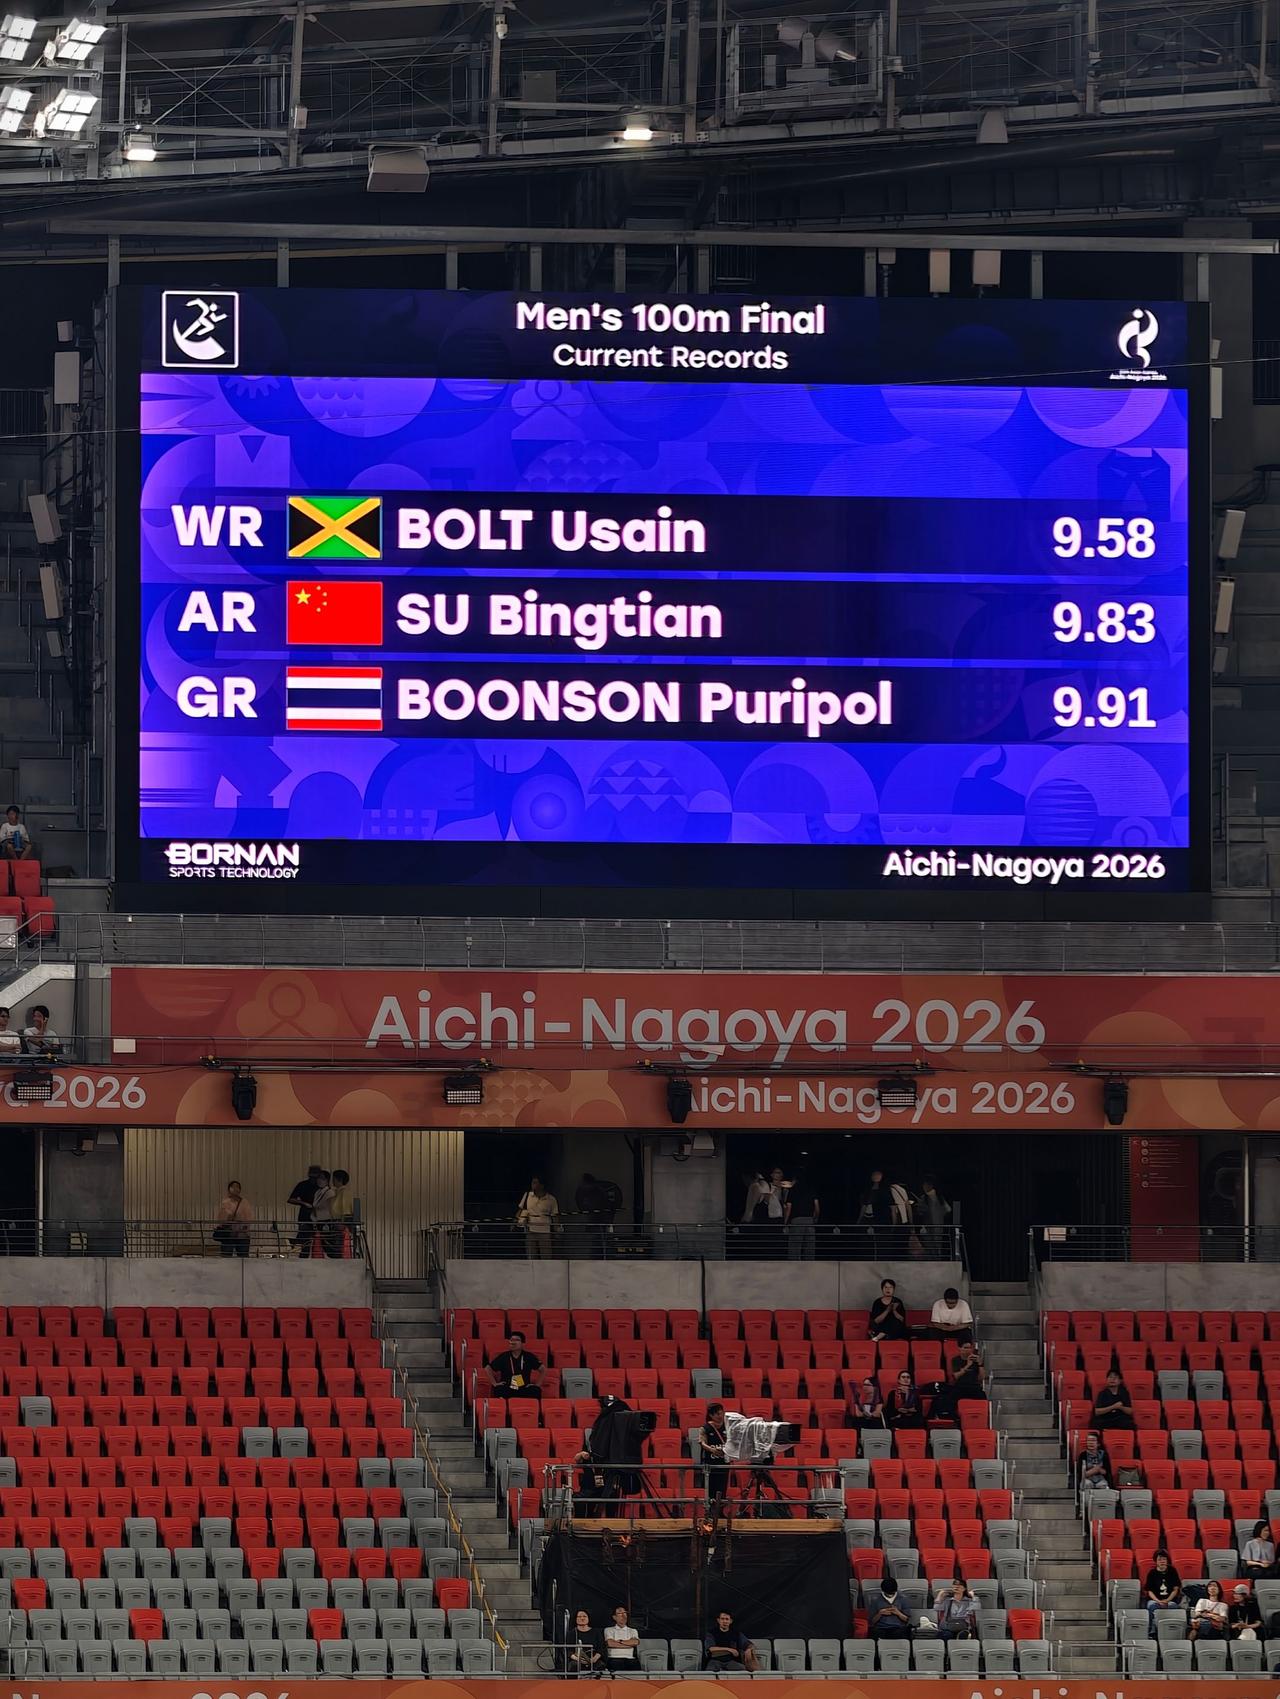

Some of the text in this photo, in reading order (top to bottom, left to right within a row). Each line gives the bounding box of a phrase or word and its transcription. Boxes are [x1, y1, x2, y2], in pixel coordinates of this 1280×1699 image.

[516, 301, 825, 335] Men's 100m Final
[553, 343, 789, 370] Current Records
[171, 505, 1156, 558] WR BOLT Usain 9.58
[177, 589, 1156, 650] AR SU Bingtian 9.83
[176, 675, 1156, 738] GR BOONSON Puripol 9.91
[164, 842, 300, 866] BORNAN
[882, 849, 1166, 885] Aichi-Nagoya 2026
[169, 867, 300, 879] SPORTS TECHNOLOGY
[366, 989, 1045, 1069] Aichi-Nagoya 2026
[43, 1075, 147, 1109] 2026
[690, 1077, 1075, 1124] ichi-Nagya 2026
